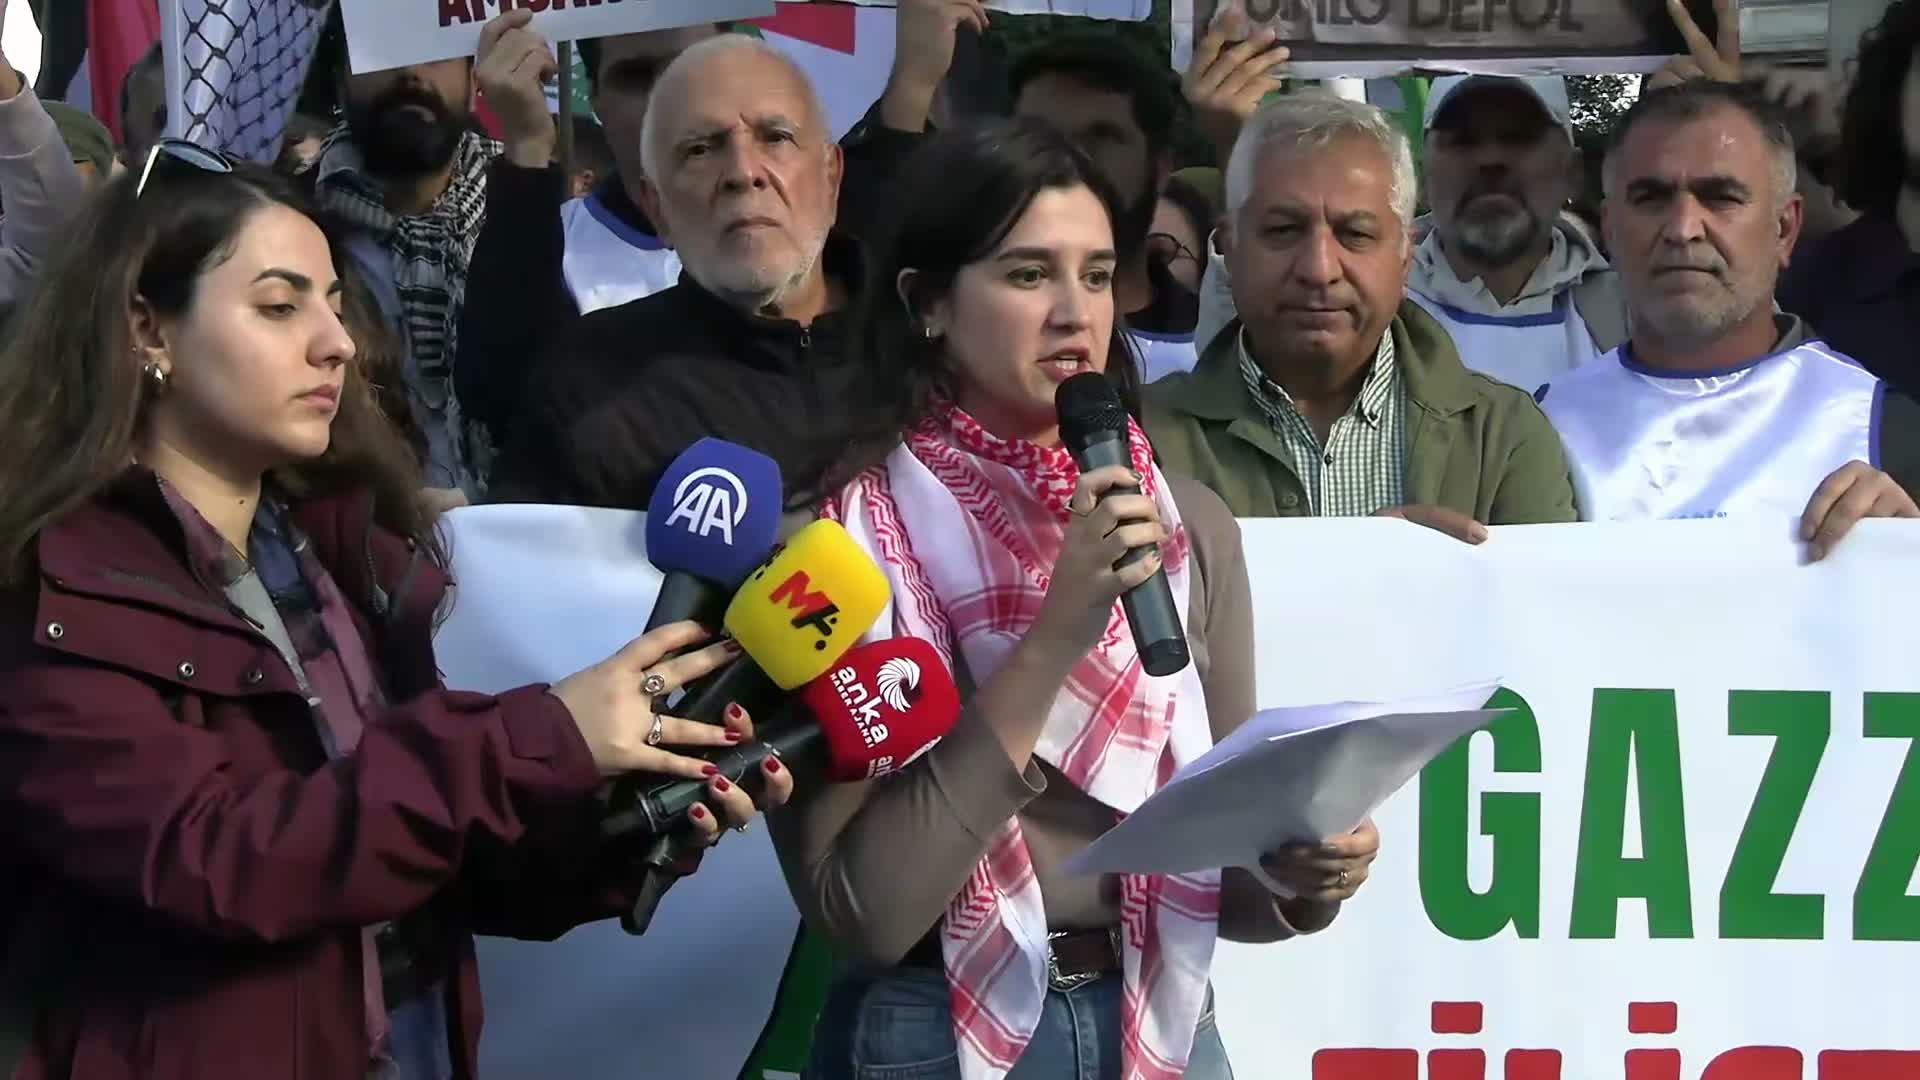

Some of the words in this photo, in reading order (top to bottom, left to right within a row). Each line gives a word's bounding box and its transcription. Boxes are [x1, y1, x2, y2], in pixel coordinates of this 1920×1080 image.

[665, 482, 734, 546] AA
[829, 672, 853, 707] HABER
[838, 666, 889, 744] anka
